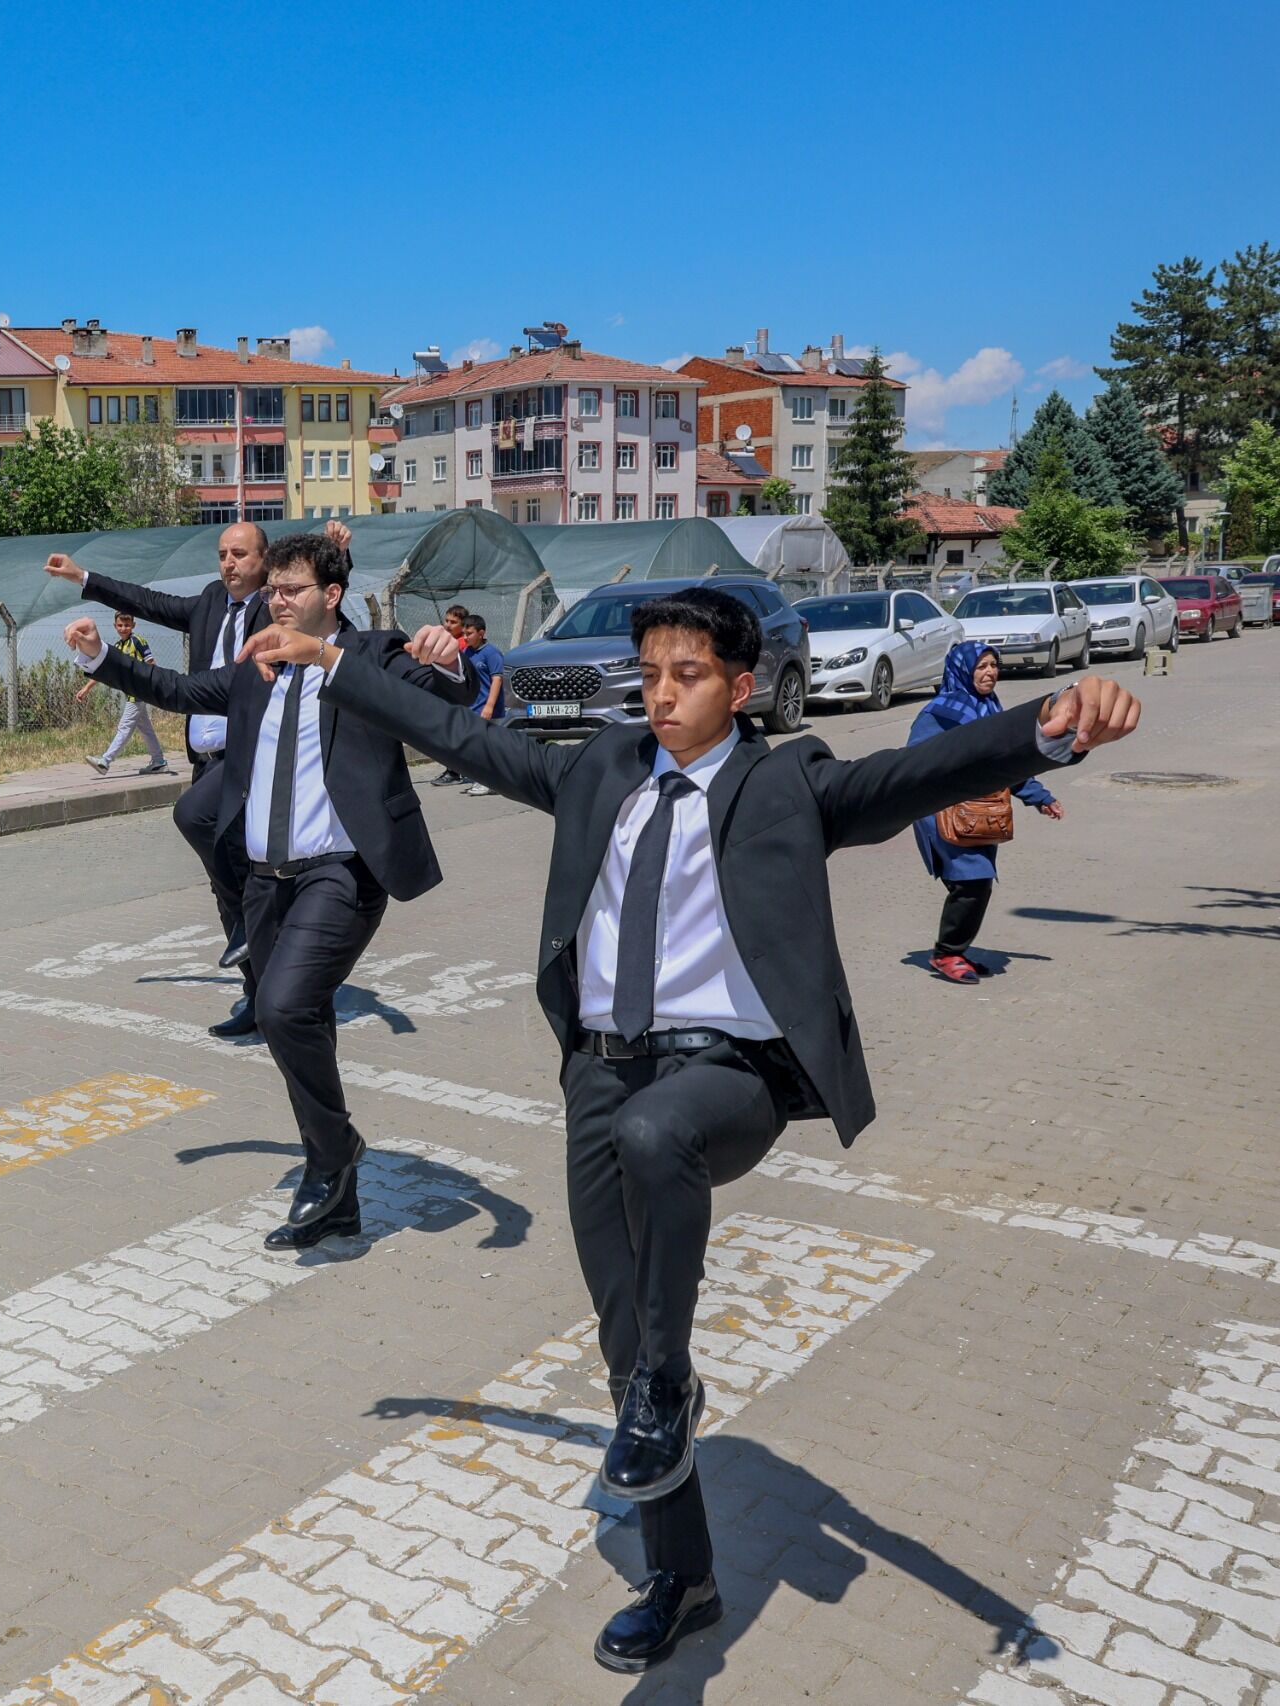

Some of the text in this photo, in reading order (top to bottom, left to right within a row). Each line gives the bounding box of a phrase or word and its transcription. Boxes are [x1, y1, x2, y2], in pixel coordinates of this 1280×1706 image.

[533, 705, 579, 715] 10 AKH 233
